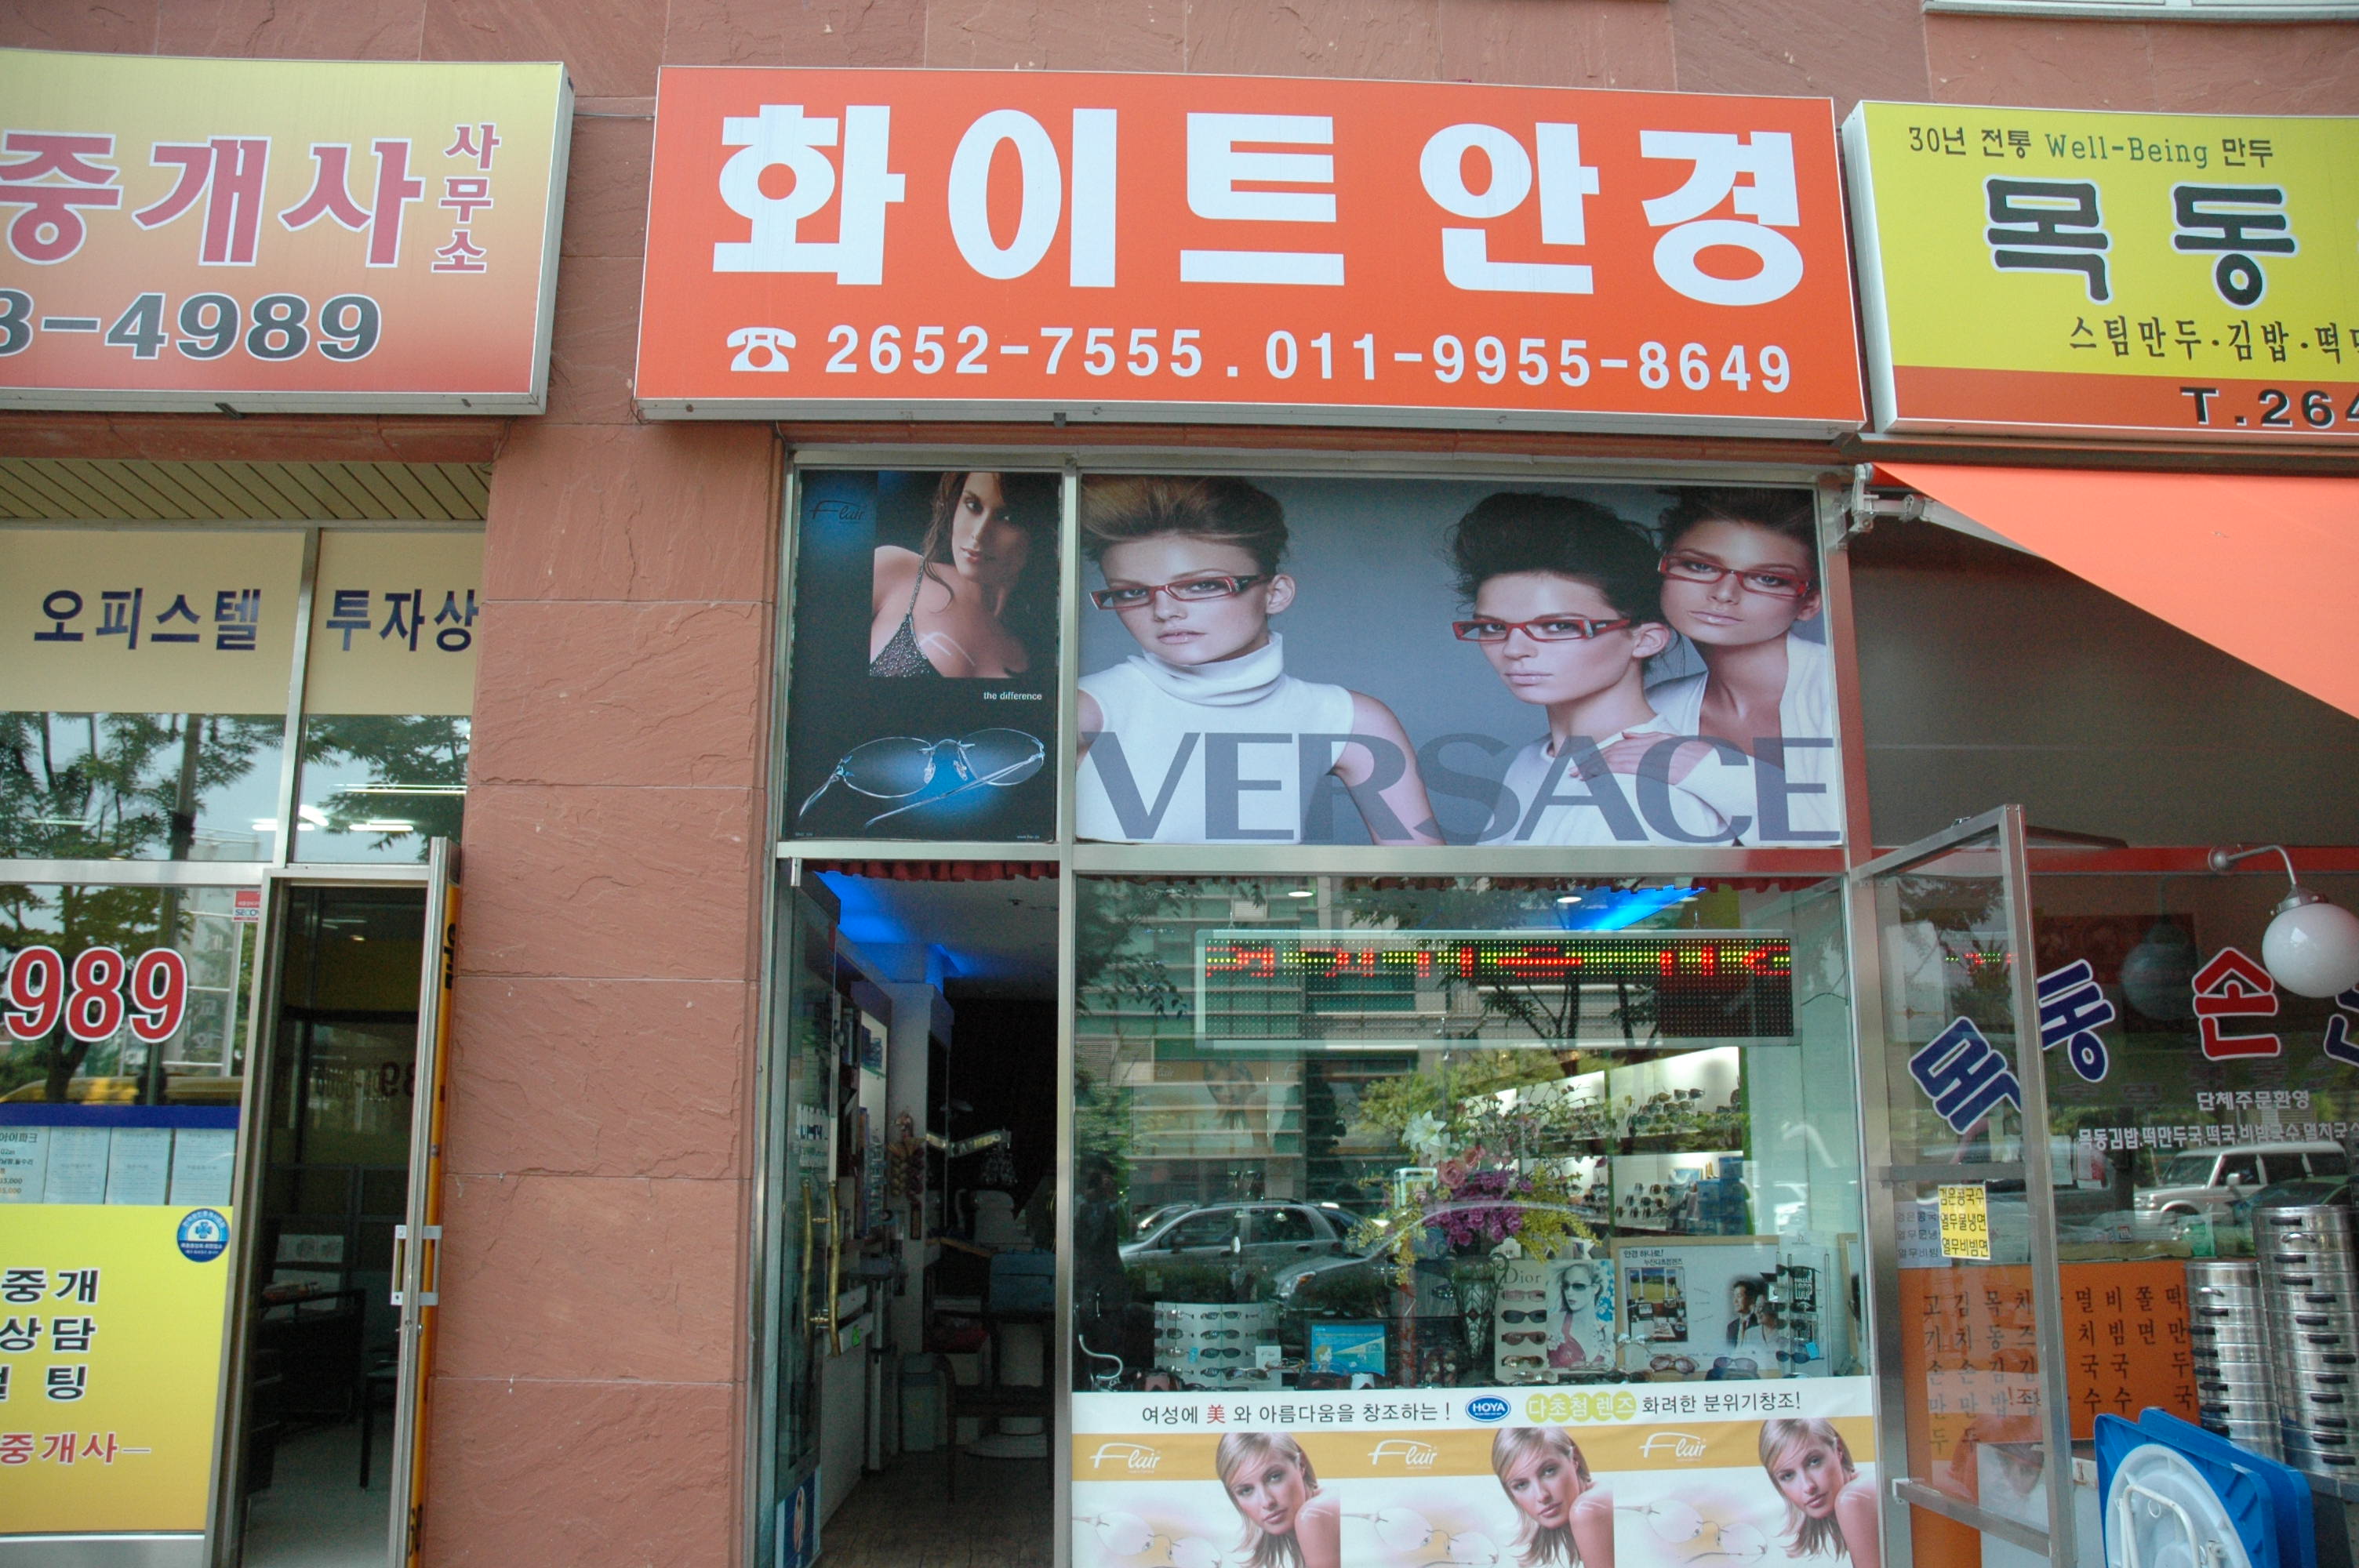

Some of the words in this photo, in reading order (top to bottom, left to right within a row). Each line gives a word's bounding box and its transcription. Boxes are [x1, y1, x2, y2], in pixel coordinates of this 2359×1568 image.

[1908, 126, 1967, 155] 30년
[1981, 128, 2032, 158] 전통
[2045, 132, 2208, 169] Well-Being
[2222, 136, 2274, 168] 만두
[0, 129, 427, 268] 중개사
[431, 122, 502, 274] 사무소
[712, 104, 1804, 307] 화이트안경
[1983, 173, 2300, 310] 목동
[34, 587, 261, 651] 오피스텔
[326, 588, 479, 652] 투자상
[983, 691, 998, 701] the
[1000, 691, 1043, 702] difference
[1081, 731, 1842, 847] VERSACE
[234, 908, 260, 917] SECO
[4, 946, 188, 1044] 989
[2197, 1089, 2310, 1112] 단체주문환영
[1940, 1212, 1986, 1232] 열무물냉면
[1942, 1237, 1990, 1258] 열무비빔면
[2, 1269, 100, 1303] 중개
[1502, 1266, 1542, 1285] Dior
[2135, 1286, 2155, 1345] 쫄면
[0, 1317, 96, 1352] 상담
[2076, 1287, 2103, 1414] 멸치국수
[2106, 1286, 2132, 1414] 비빔국수
[2165, 1283, 2194, 1410] 떡만두국
[1142, 1405, 1198, 1425] 여성에
[1206, 1404, 1226, 1424] 美
[1233, 1404, 1252, 1424] 와
[1259, 1403, 1356, 1424] 아름다움을
[1472, 1402, 1507, 1414] HOYA
[1597, 1395, 1637, 1417] 렌즈
[1642, 1396, 1696, 1414] 화려한
[1703, 1392, 1801, 1412] 분위기창조!
[0, 1430, 118, 1465] 중개사
[1089, 1443, 1161, 1468] Flair
[1367, 1439, 1438, 1466] Flair
[1639, 1432, 1707, 1459] Flair
